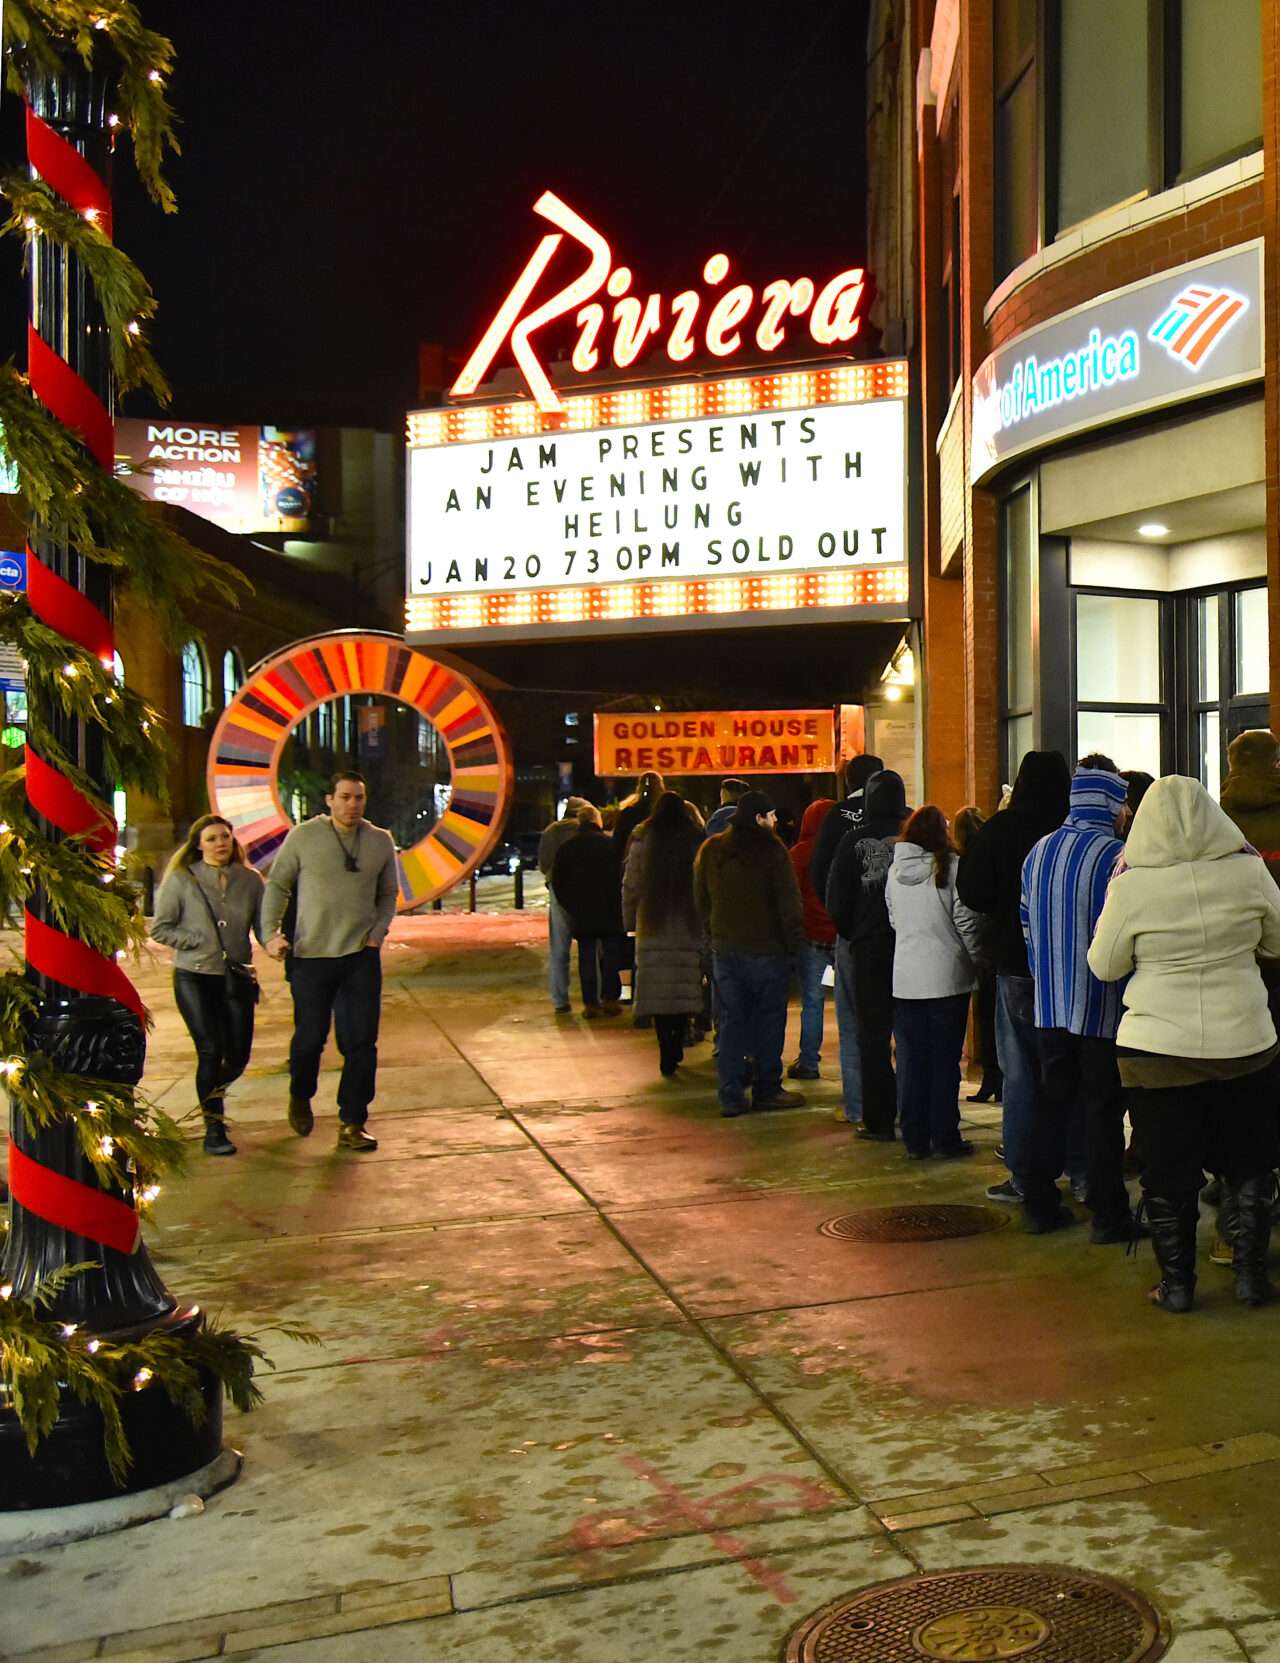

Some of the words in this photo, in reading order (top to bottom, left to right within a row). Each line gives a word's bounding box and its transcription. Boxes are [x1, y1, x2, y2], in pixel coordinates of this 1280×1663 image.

[451, 190, 865, 412] Riviera
[148, 426, 240, 447] MORE
[480, 443, 557, 475] JAM
[598, 417, 817, 463] PRESENTS
[149, 444, 240, 463] ACTION
[445, 485, 492, 513] AN
[527, 464, 708, 507] EVENING
[739, 451, 863, 488] WITH
[564, 501, 743, 539] HEILUNG
[707, 534, 795, 566] SOLD
[818, 527, 888, 559] OUT
[0, 567, 18, 577] cta
[613, 721, 716, 740] GOLDEN
[733, 718, 819, 738] HOUSE
[614, 743, 819, 770] RESTAURANT
